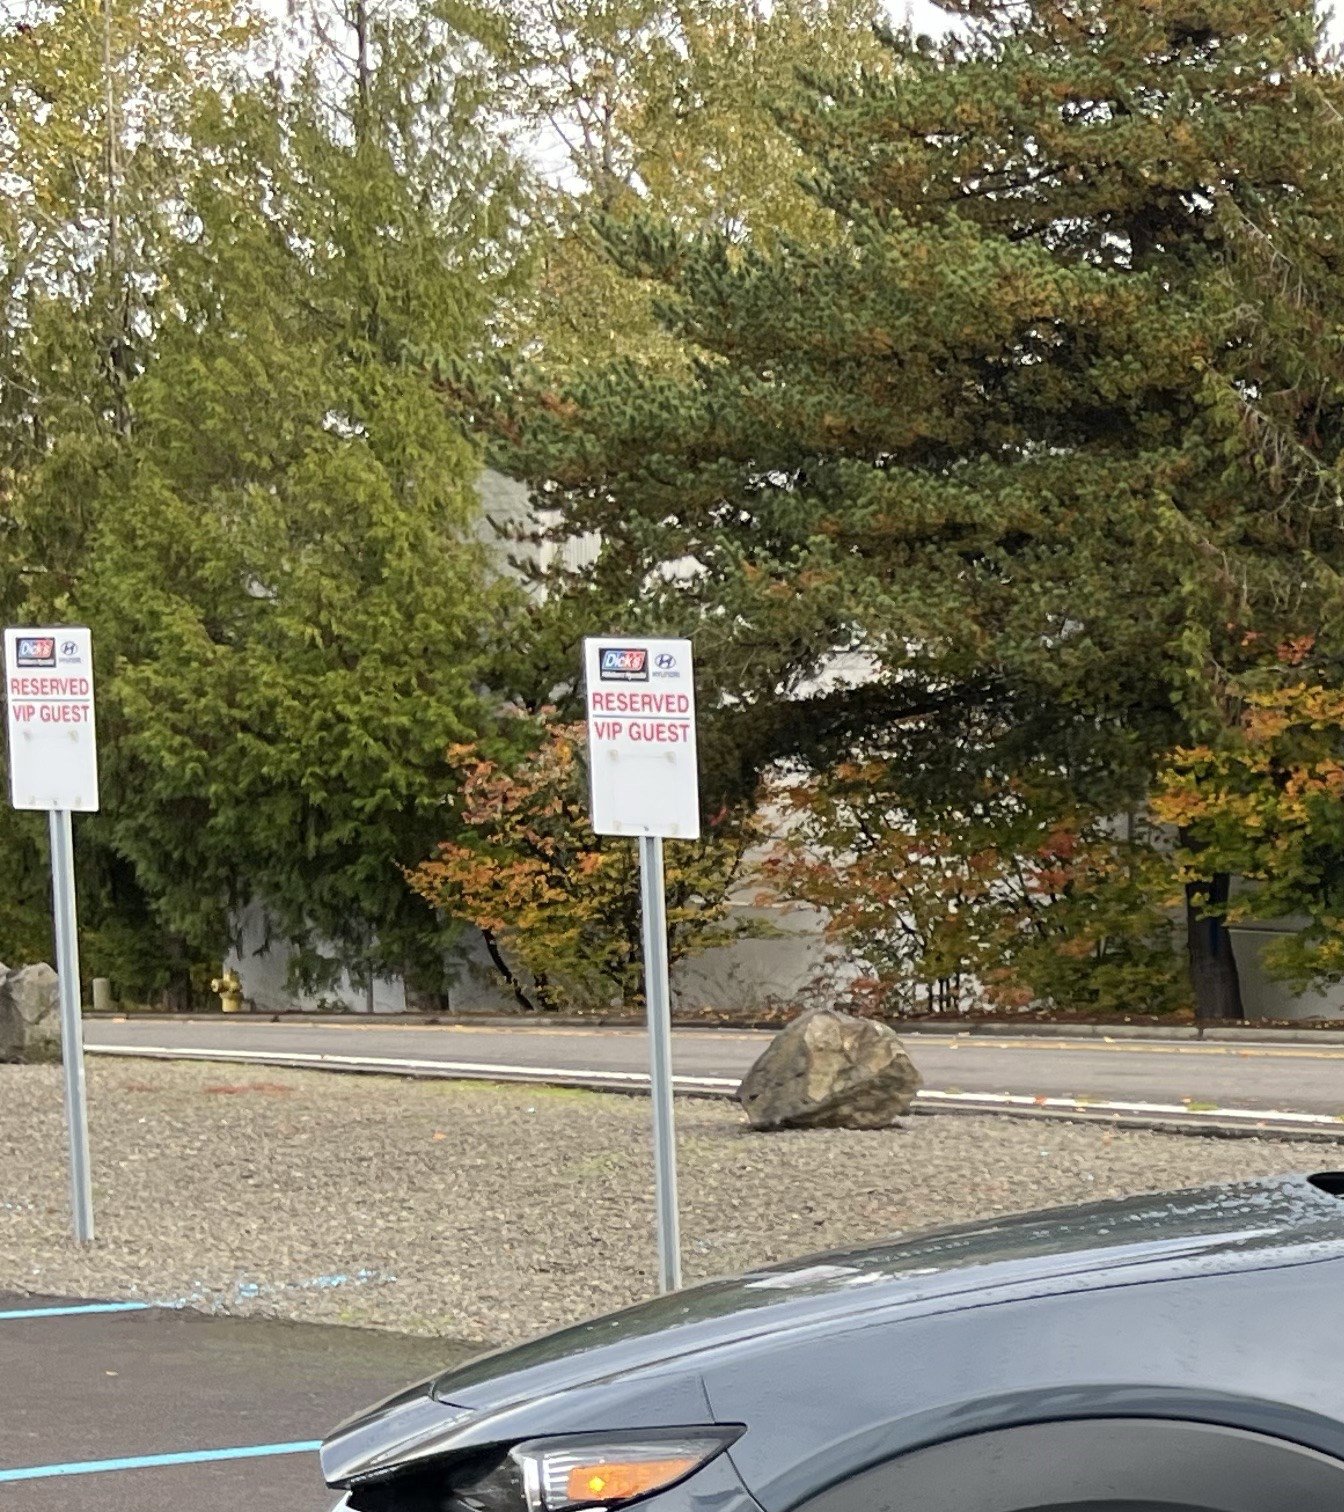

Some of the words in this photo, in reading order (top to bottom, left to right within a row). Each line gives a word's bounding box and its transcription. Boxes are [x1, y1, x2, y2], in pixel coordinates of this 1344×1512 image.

[11, 678, 89, 696] RESERVED
[592, 692, 689, 713] RESERVED
[13, 705, 35, 722] VIP
[40, 704, 90, 722] GUEST
[594, 721, 622, 740] VIP
[628, 722, 690, 742] GUEST
